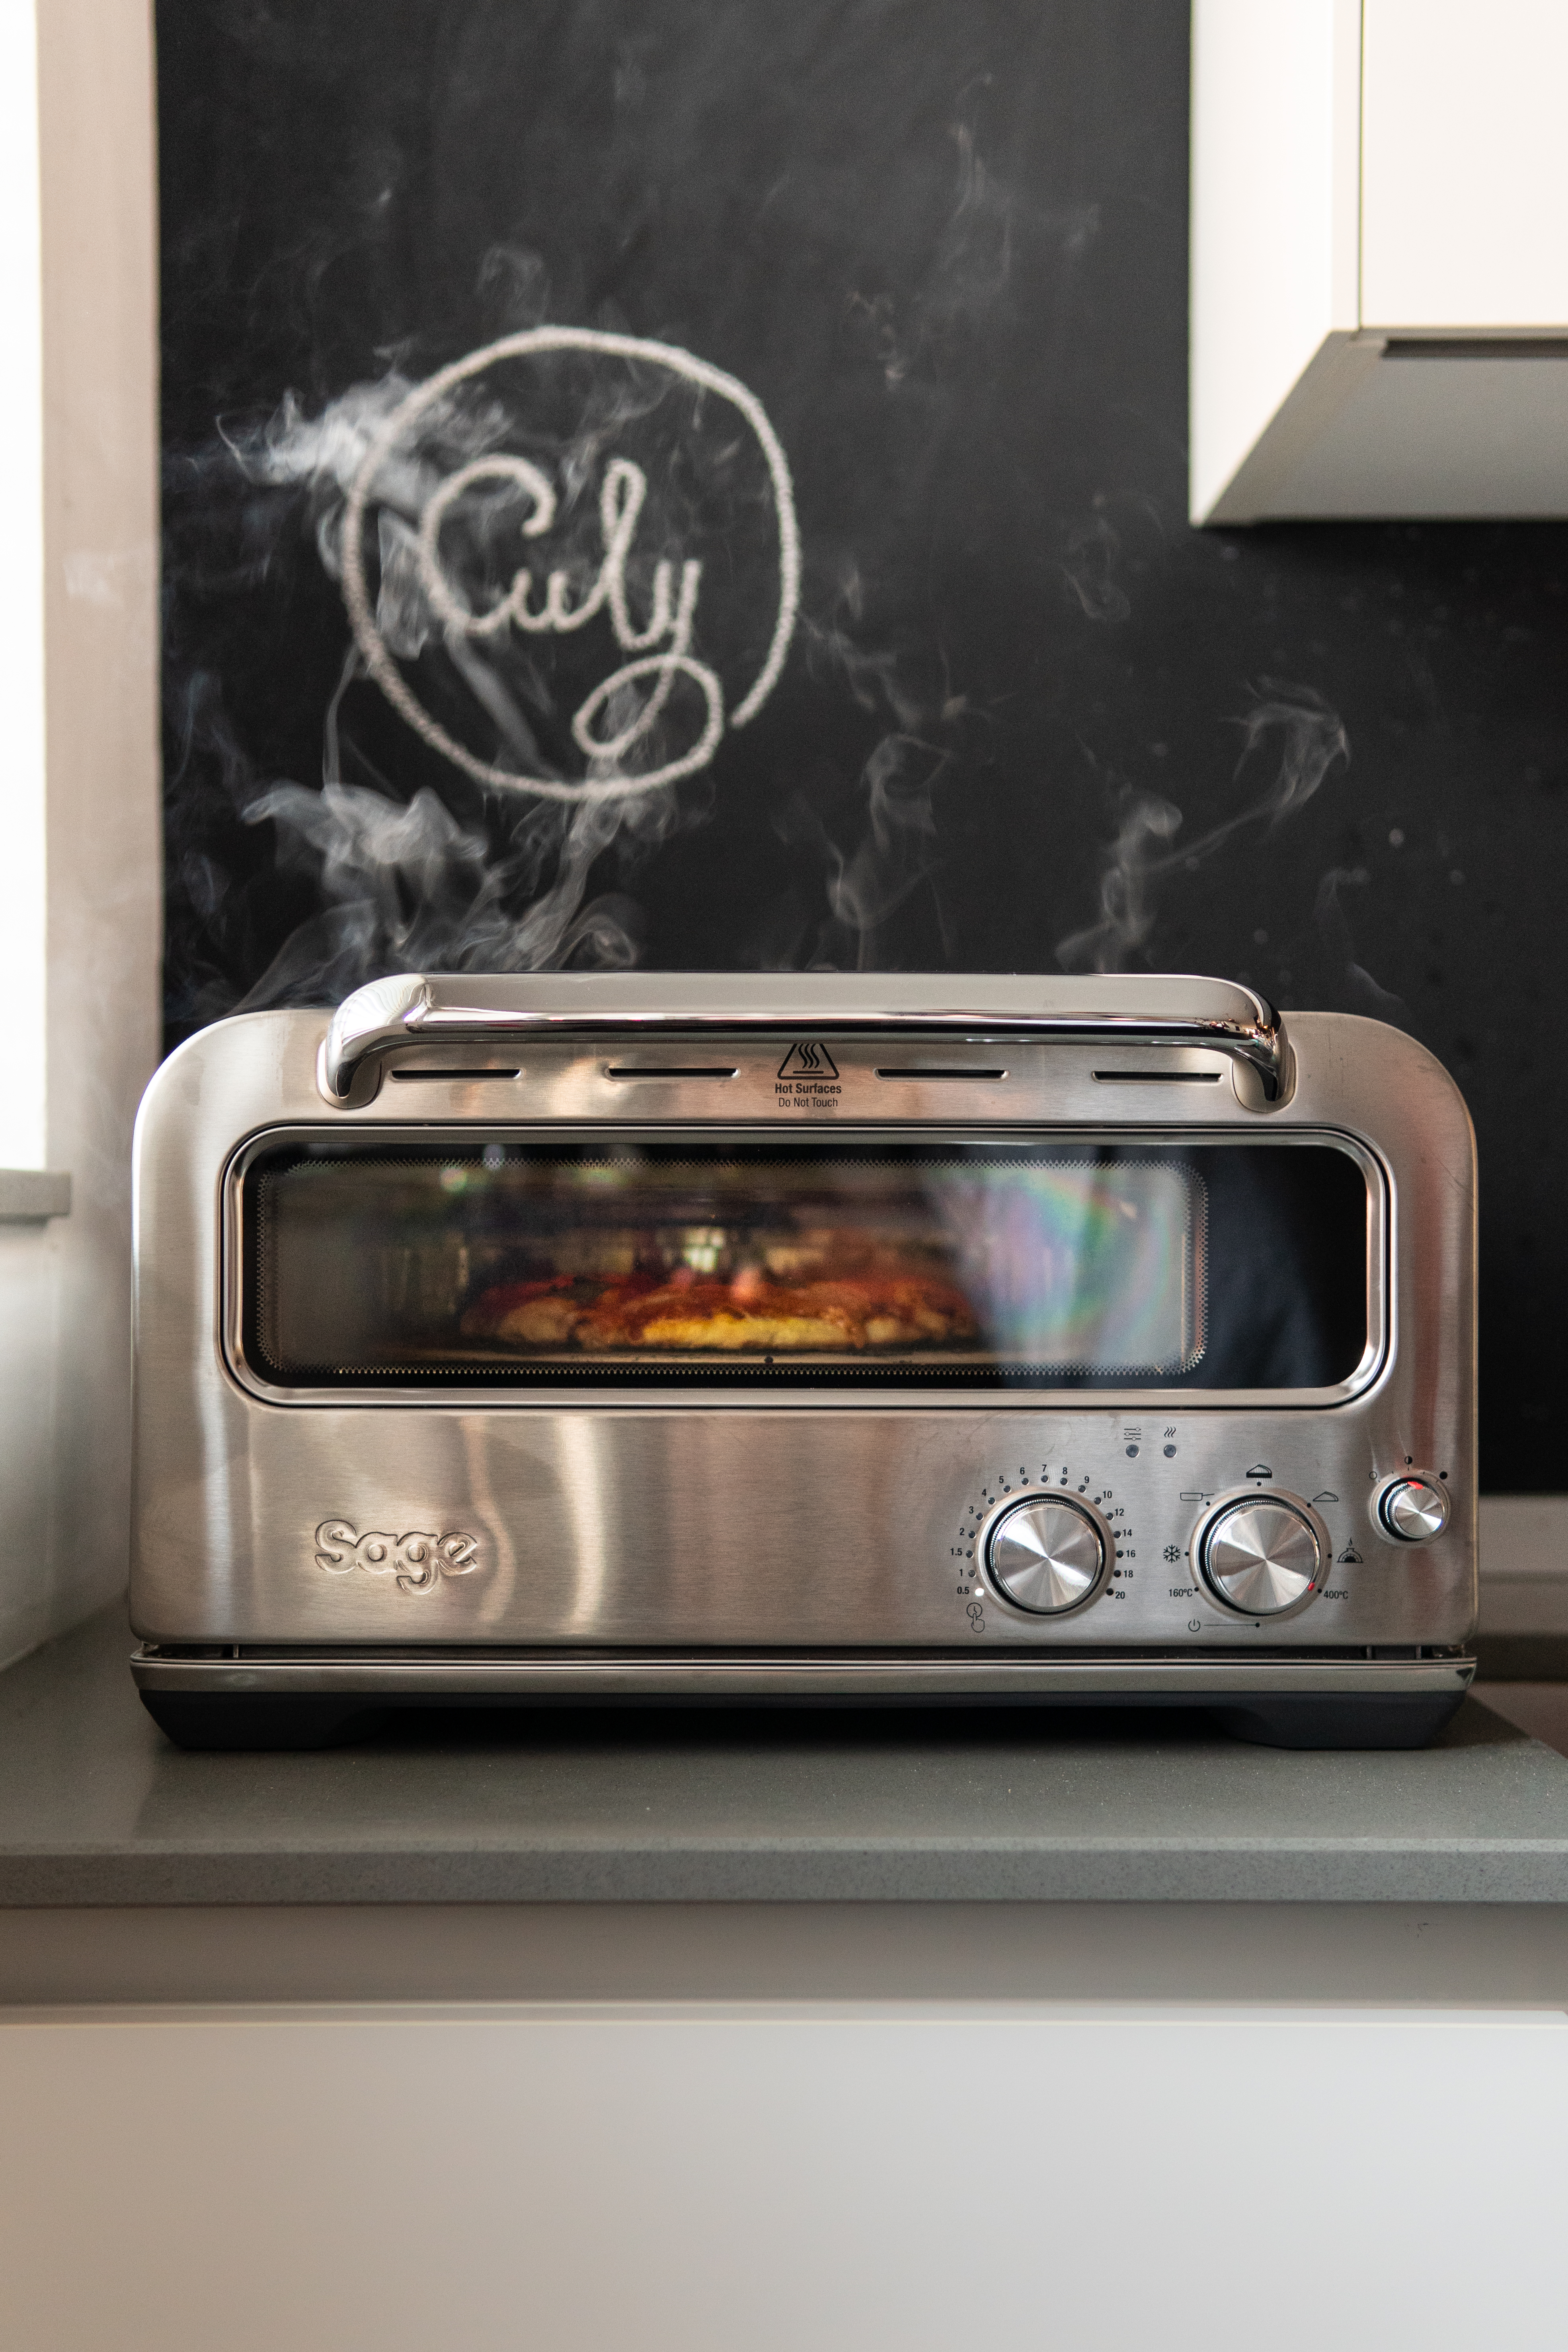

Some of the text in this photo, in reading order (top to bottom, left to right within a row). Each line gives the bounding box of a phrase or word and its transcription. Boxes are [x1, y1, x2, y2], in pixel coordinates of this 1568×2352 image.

[420, 454, 724, 758] Culy
[775, 1083, 842, 1093] Hot Surfaces
[779, 1098, 838, 1107] Do Not Touch
[315, 1519, 477, 1595] Sage
